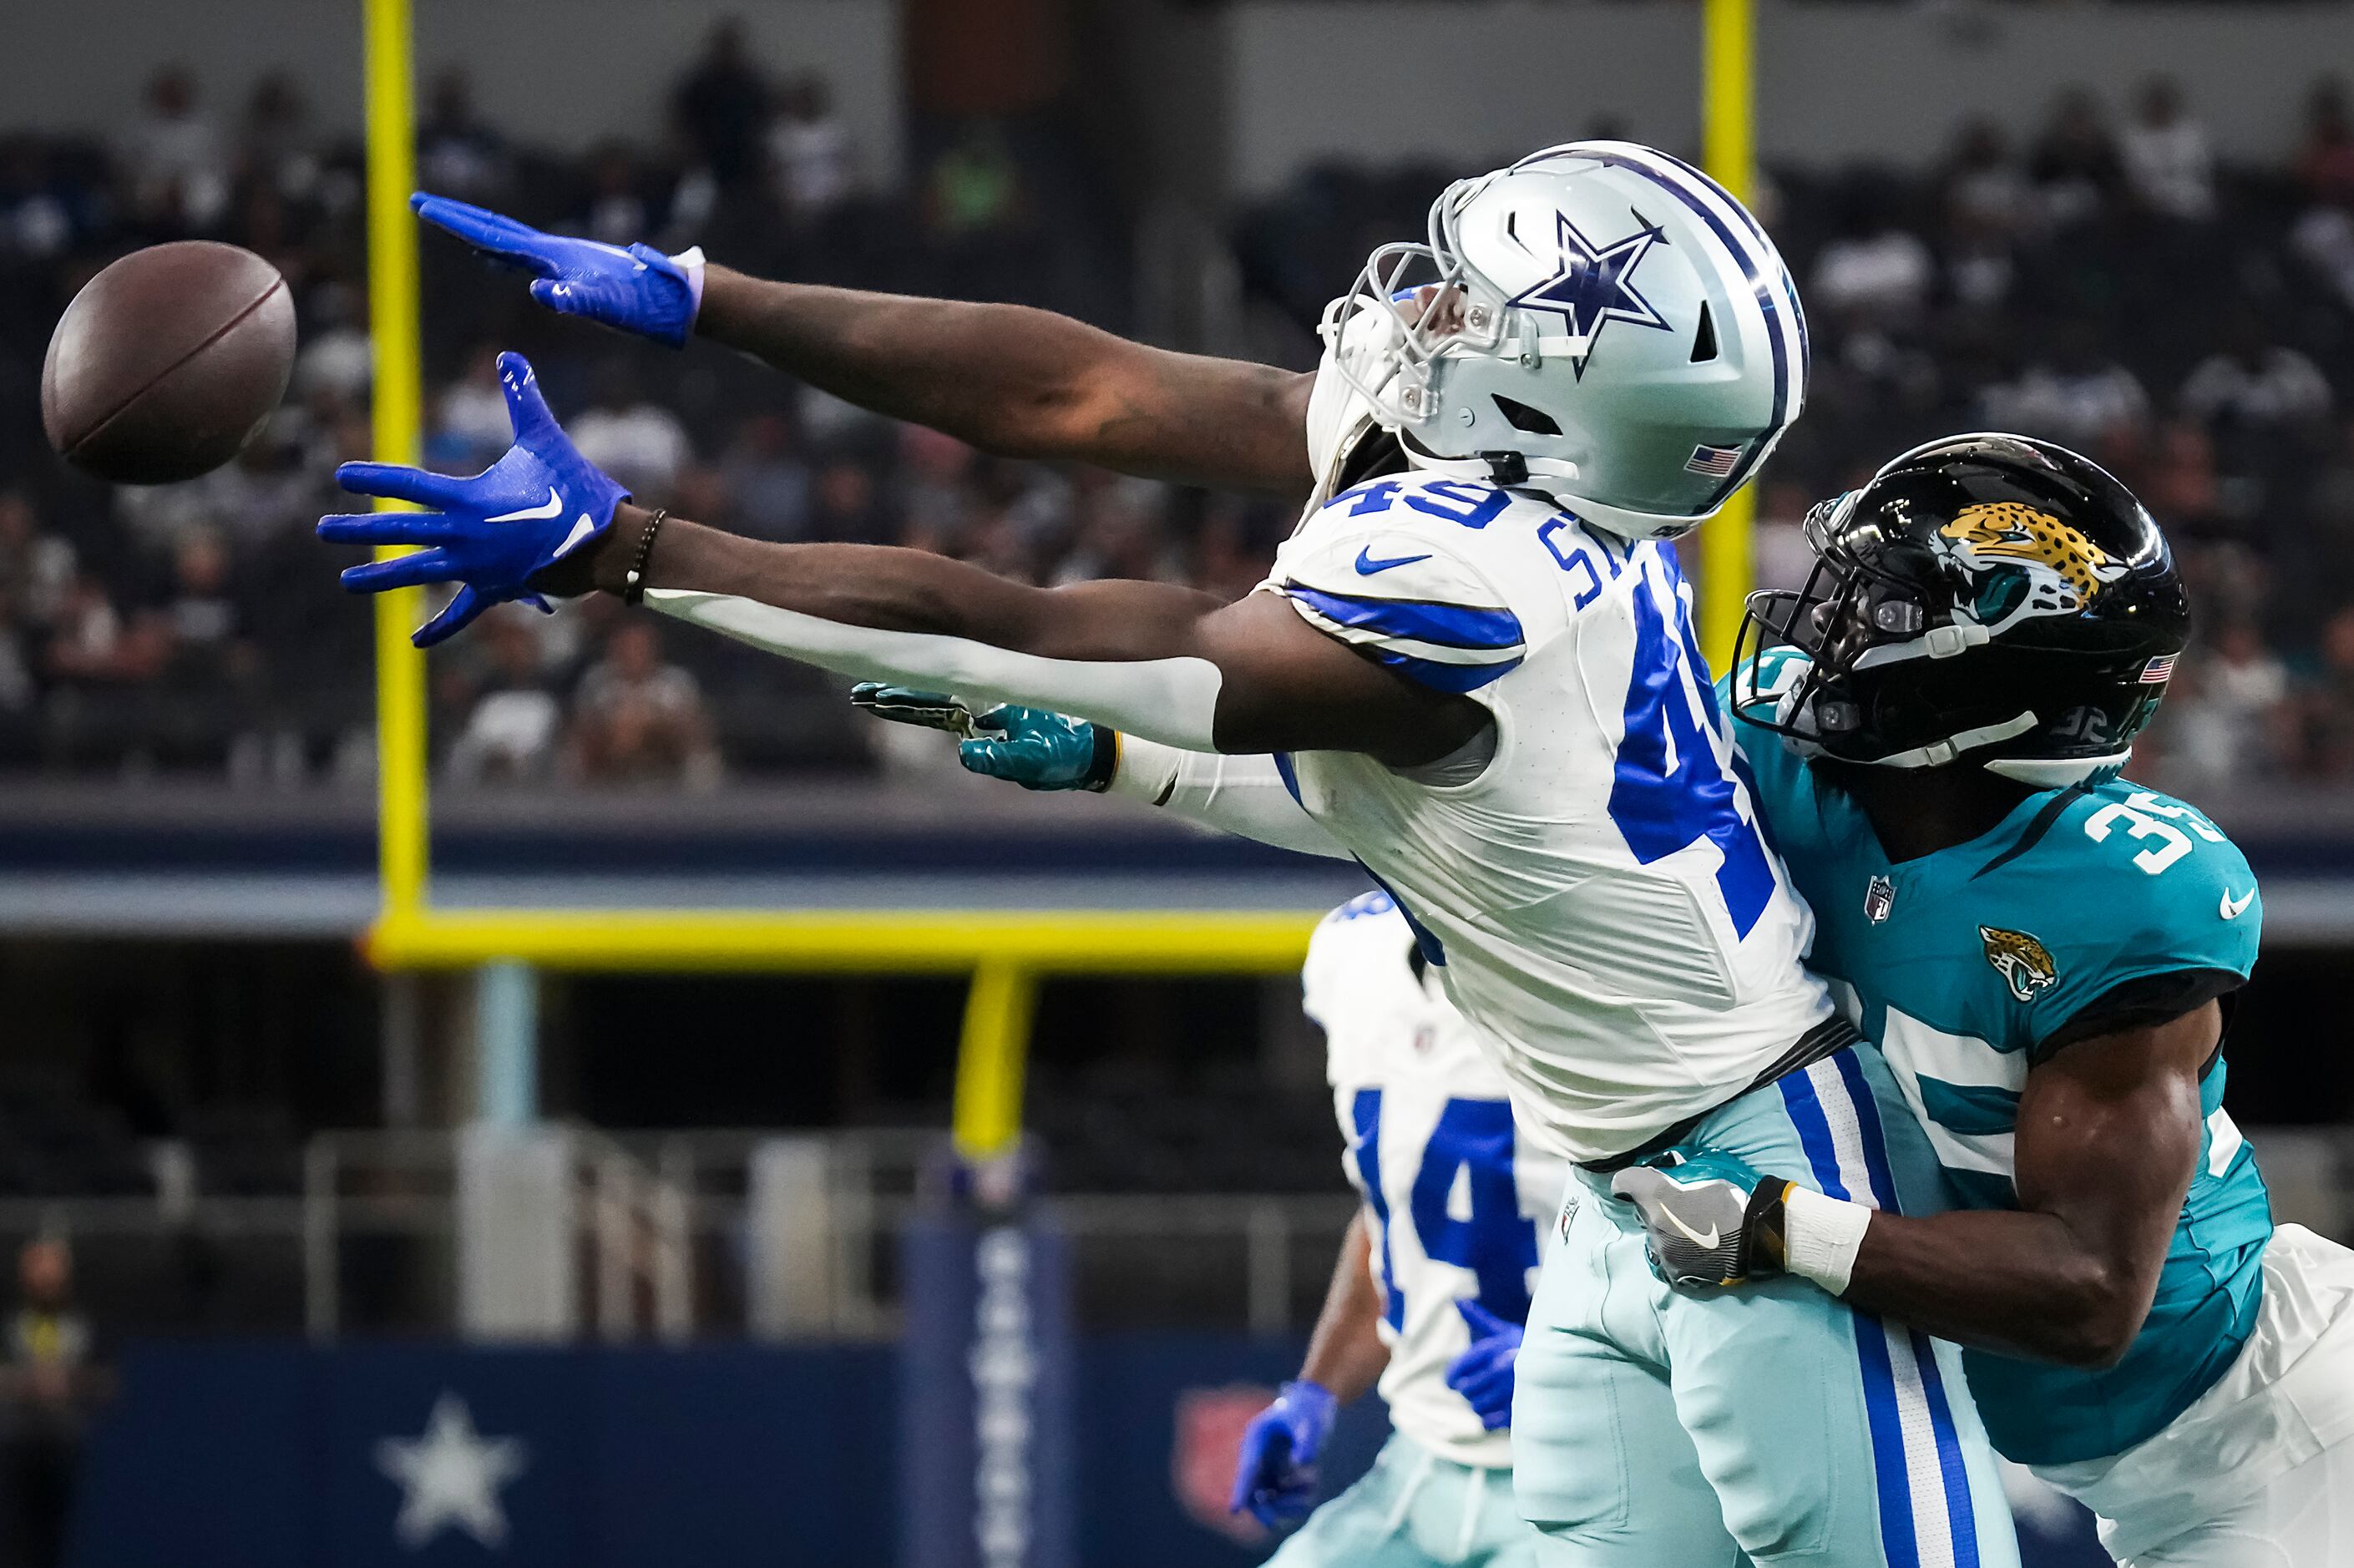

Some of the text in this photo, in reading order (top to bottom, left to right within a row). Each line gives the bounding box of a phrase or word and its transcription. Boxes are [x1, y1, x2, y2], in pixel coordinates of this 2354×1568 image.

[1323, 480, 1513, 529] 49
[2084, 792, 2227, 875] 35
[1352, 1089, 1540, 1336] 14
